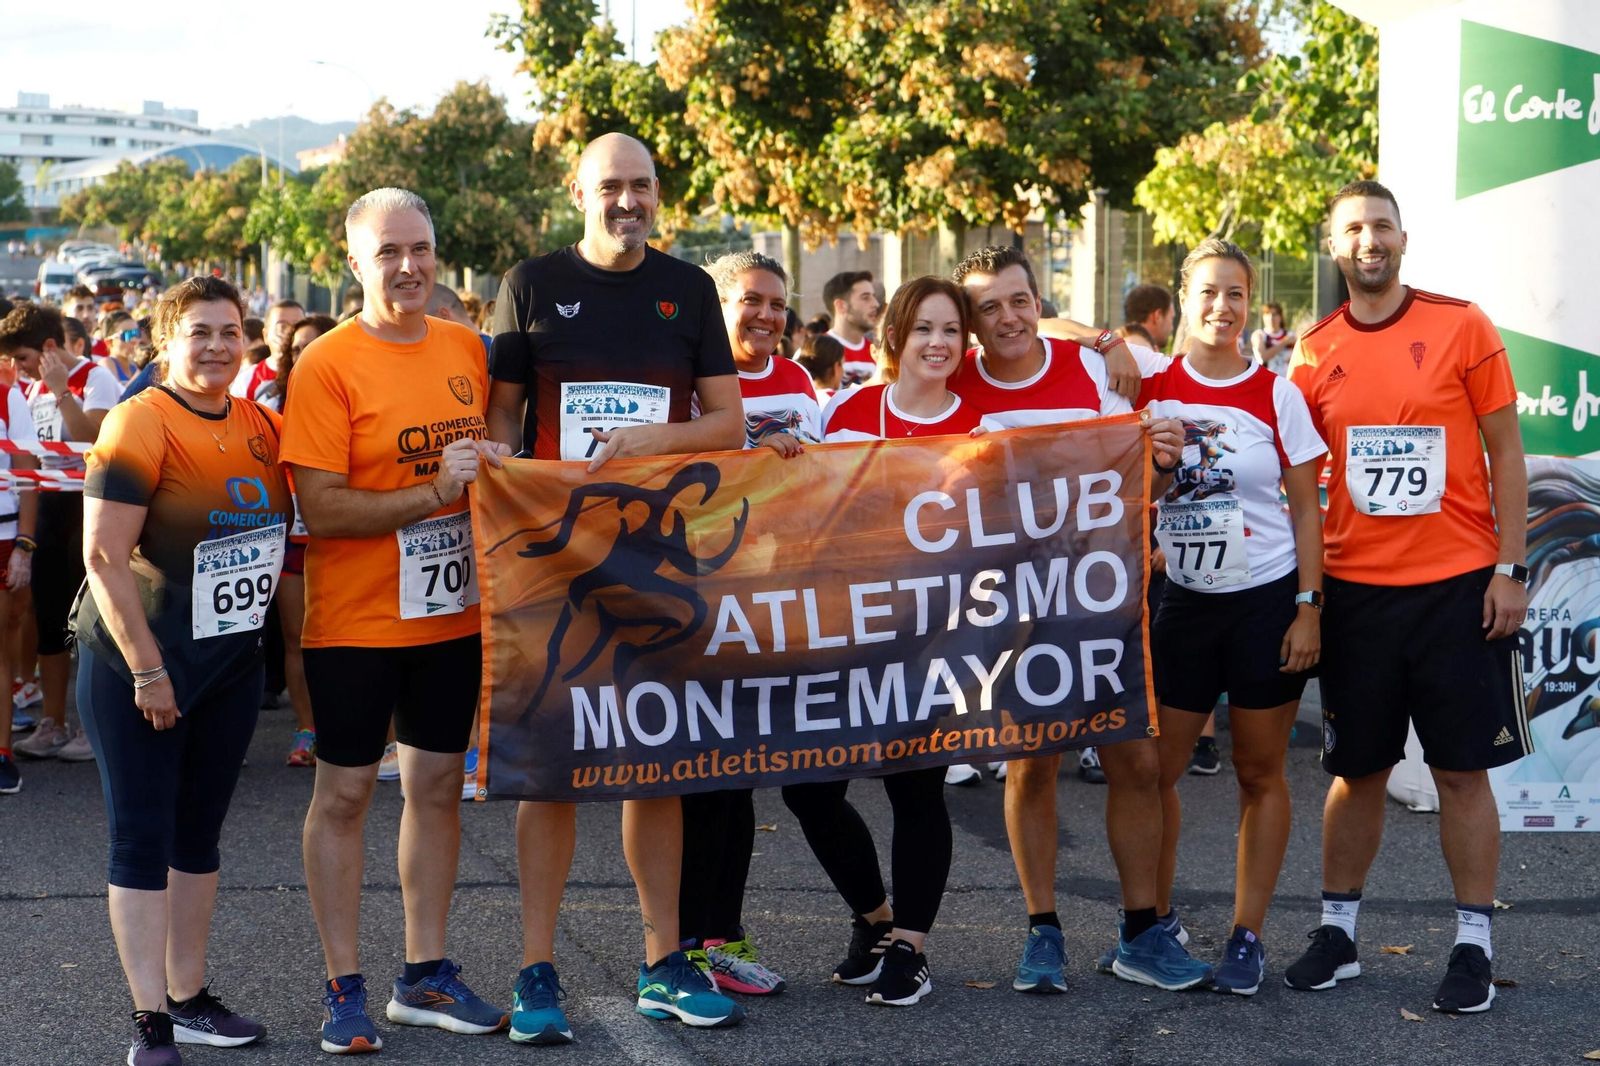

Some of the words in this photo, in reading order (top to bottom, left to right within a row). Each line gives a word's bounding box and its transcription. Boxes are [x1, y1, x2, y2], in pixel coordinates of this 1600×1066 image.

[1463, 84, 1496, 124] El
[1504, 84, 1583, 122] Corte
[1327, 373, 1346, 382] adidas
[1516, 386, 1568, 416] orte
[1365, 466, 1427, 496] 779
[904, 470, 1124, 552] CLUB
[1172, 540, 1226, 570] 777
[422, 555, 470, 597] 700
[213, 574, 272, 614] 699
[704, 550, 1128, 656] ATLETISMO
[1527, 608, 1572, 620] RERA
[570, 638, 1125, 750] MONTEMAYOR
[1544, 682, 1576, 692] 19:30H
[572, 708, 1126, 788] www.atletismomontemayor.es
[1494, 736, 1514, 746] adidas
